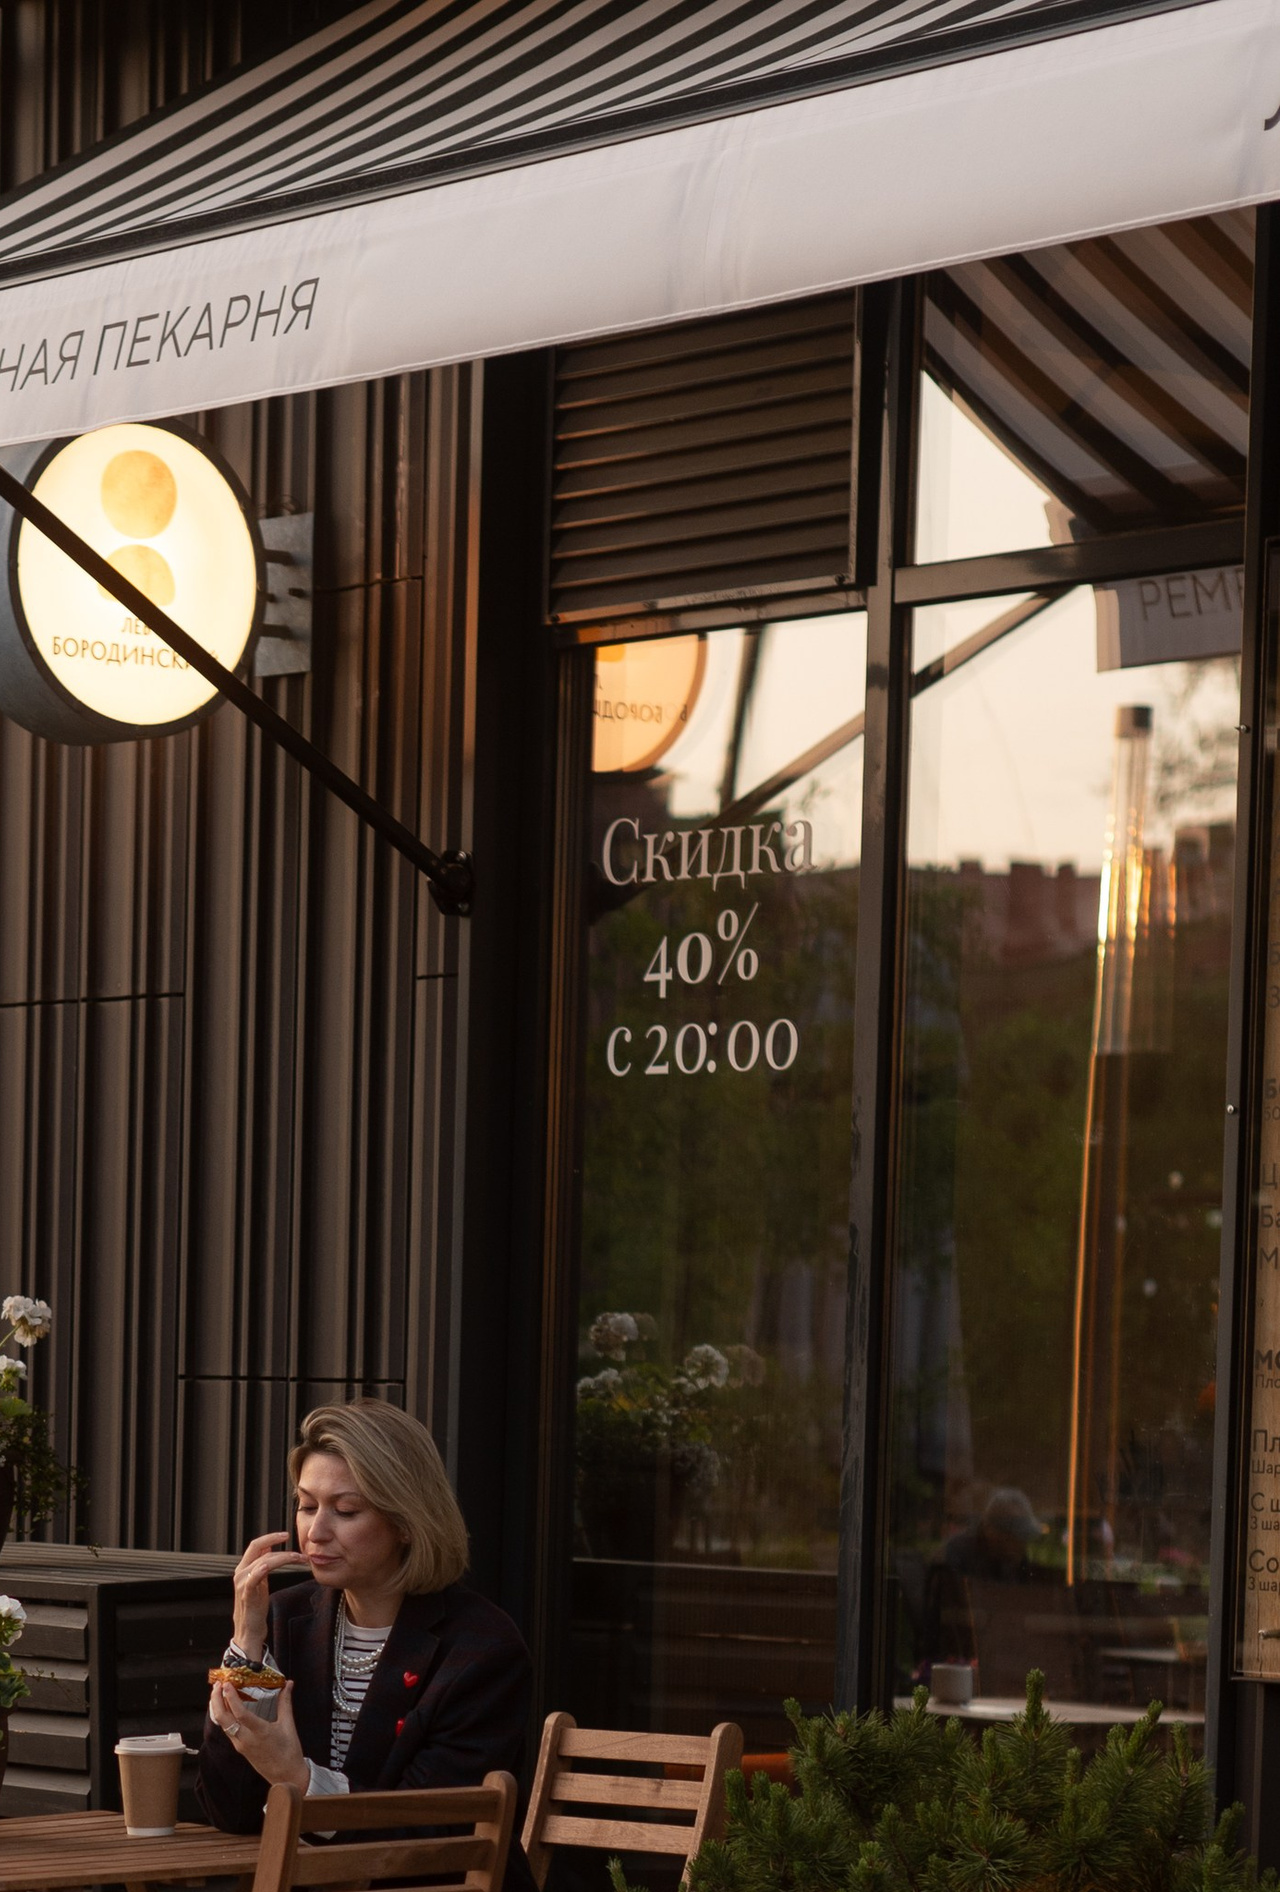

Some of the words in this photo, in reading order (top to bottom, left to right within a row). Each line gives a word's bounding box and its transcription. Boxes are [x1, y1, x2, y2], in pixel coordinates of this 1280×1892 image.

[92, 276, 320, 376] ПЕКАРНЯ
[602, 817, 818, 892] Скидка
[643, 902, 758, 999] 40%
[644, 1018, 799, 1076] 20:00
